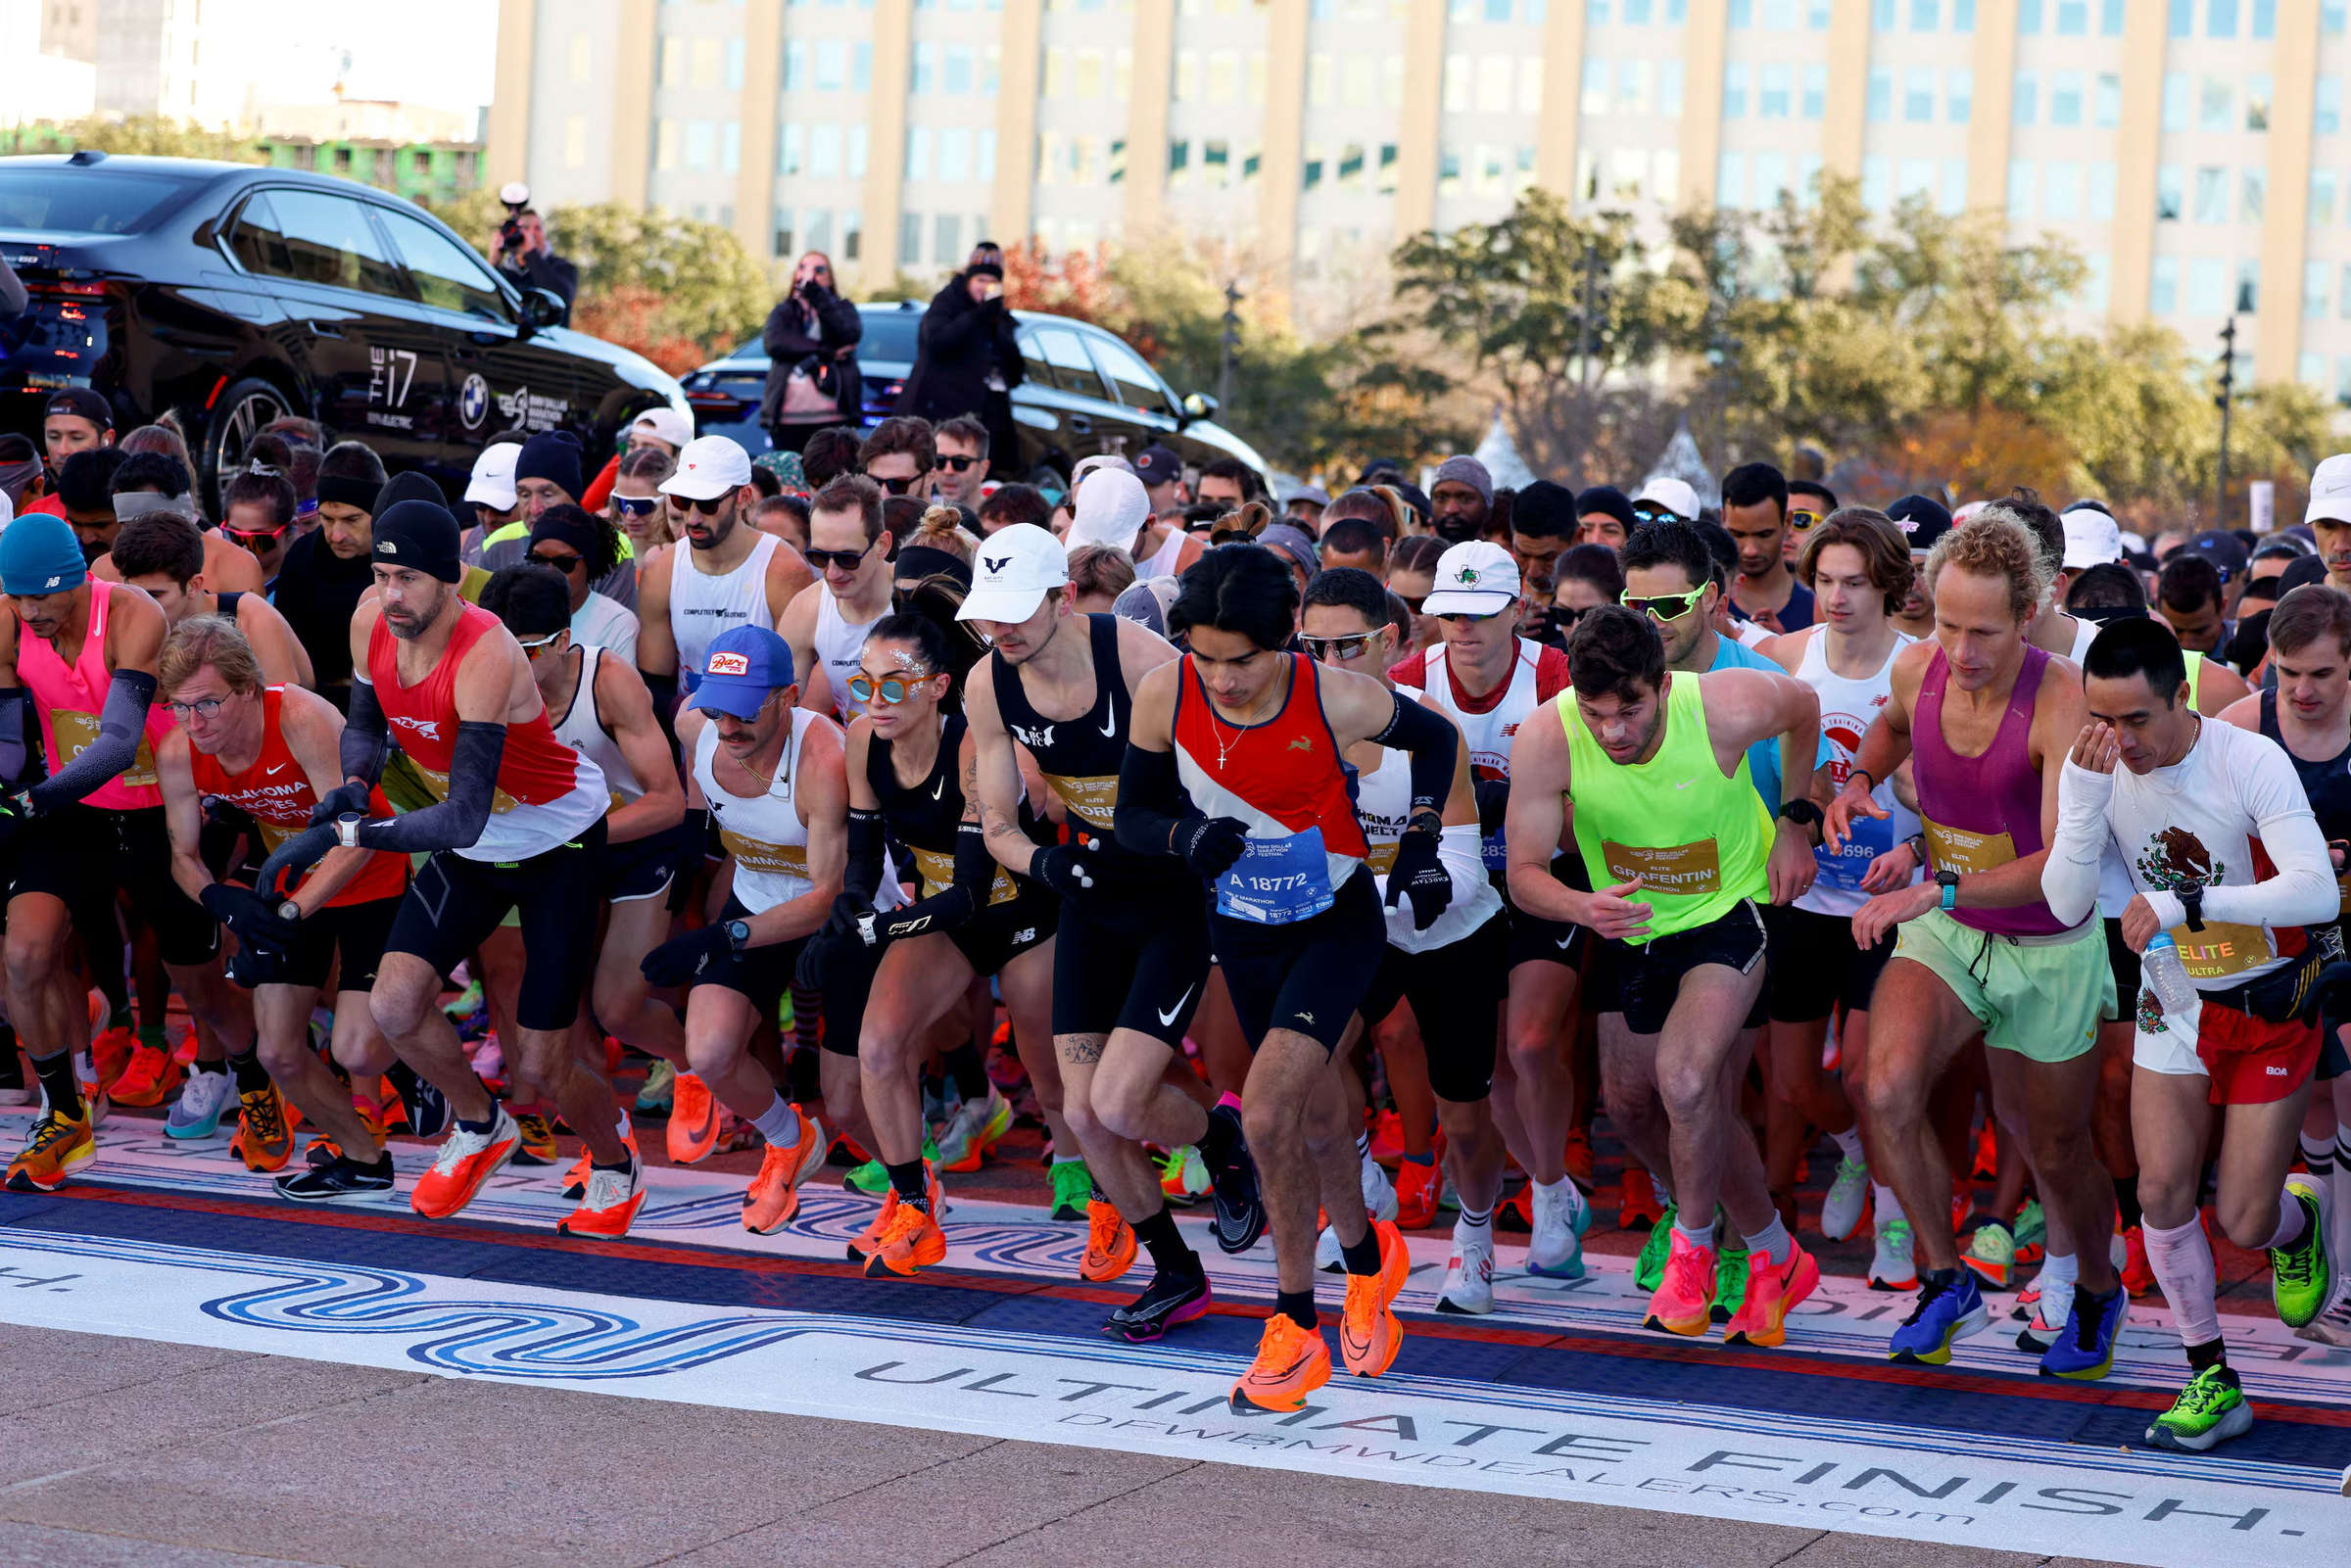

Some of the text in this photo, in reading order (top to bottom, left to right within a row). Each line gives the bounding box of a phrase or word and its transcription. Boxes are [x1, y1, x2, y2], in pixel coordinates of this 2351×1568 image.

[368, 346, 385, 404] THE
[387, 349, 417, 408] i7
[712, 655, 744, 669] Bare
[1829, 719, 1863, 734] TRAINING
[1954, 837, 1980, 846] MARATHON
[736, 854, 809, 872] AMMONS
[1951, 853, 1970, 862] ELITE
[1230, 873, 1308, 891] A 18772
[1612, 864, 1712, 884] GRAFENTIN
[1240, 895, 1275, 905] MARATHON
[2178, 942, 2235, 960] ELITE
[2186, 966, 2225, 975] ULTRA
[2266, 1067, 2288, 1075] BOA
[853, 1360, 2306, 1537] ULTIMATE FINISH.
[1056, 1412, 1976, 1525] DFWBMWDEALERS.com
